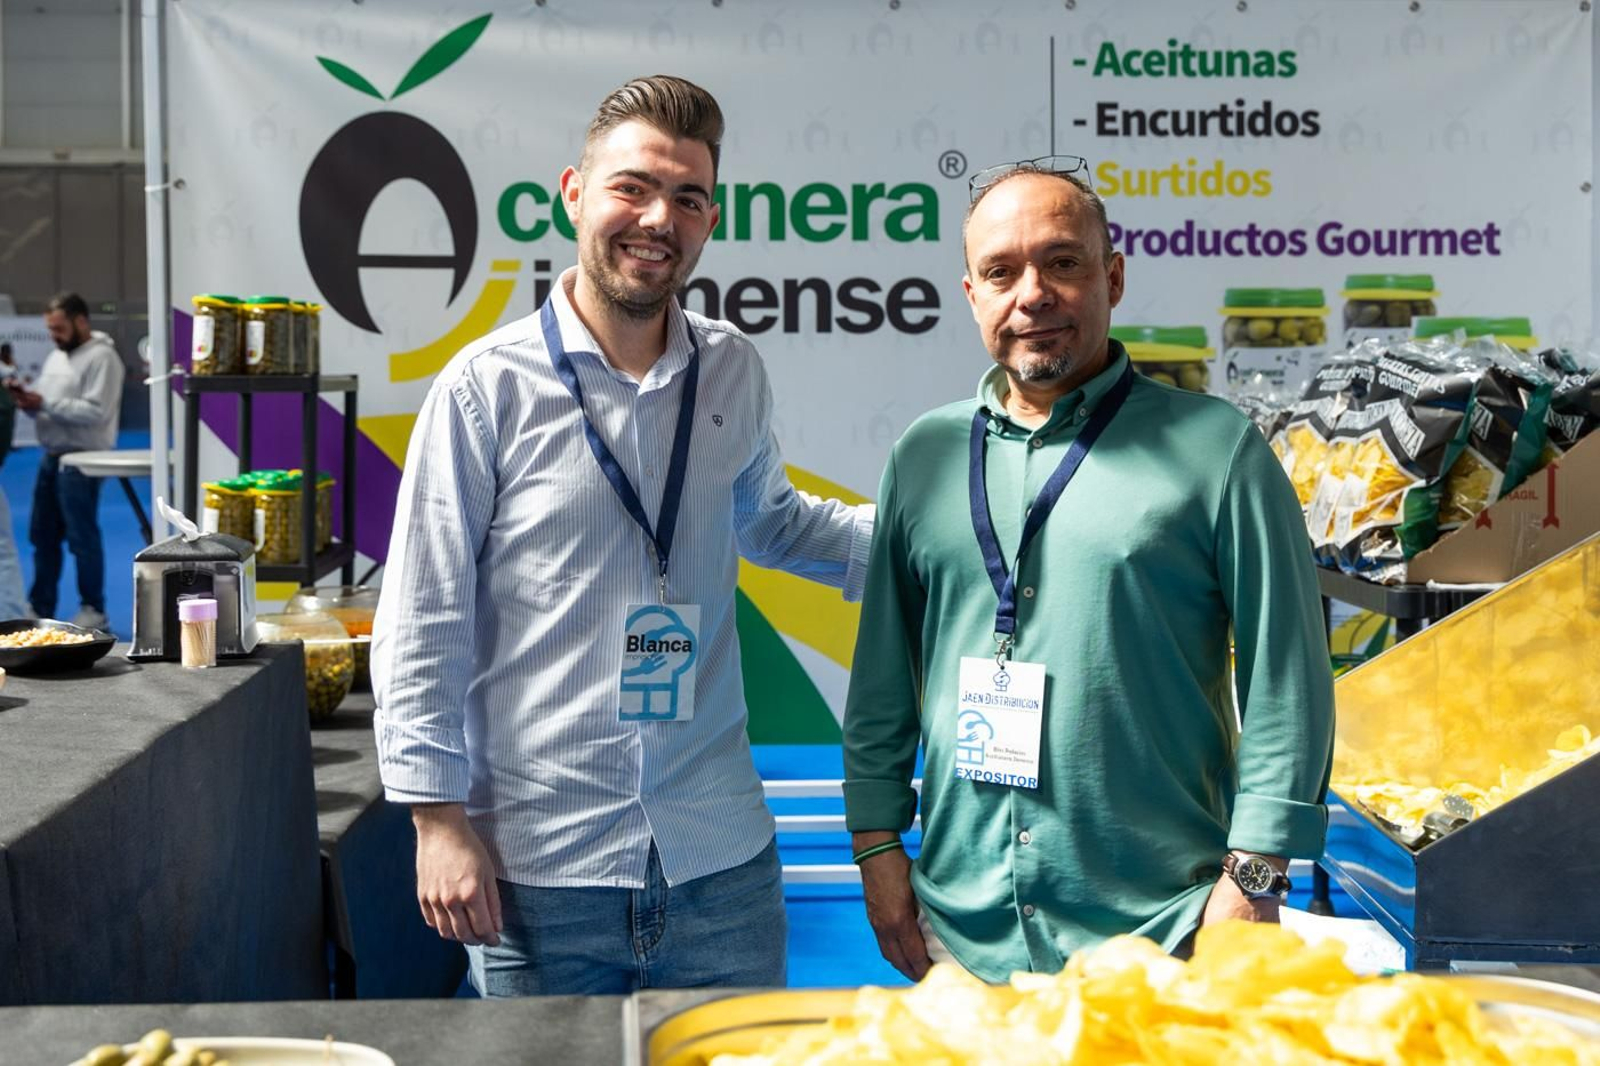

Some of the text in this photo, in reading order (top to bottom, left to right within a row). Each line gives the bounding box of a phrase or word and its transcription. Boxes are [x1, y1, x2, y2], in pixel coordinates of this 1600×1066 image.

[1092, 38, 1298, 78] Aceitunas
[1096, 98, 1320, 138] Encurtidos
[1096, 158, 1273, 197] Surtidos
[497, 181, 940, 242] cnera
[1107, 219, 1501, 257] Productos Gourmet
[626, 633, 693, 653] Blanca
[954, 767, 1037, 787] EXPOSITOR
